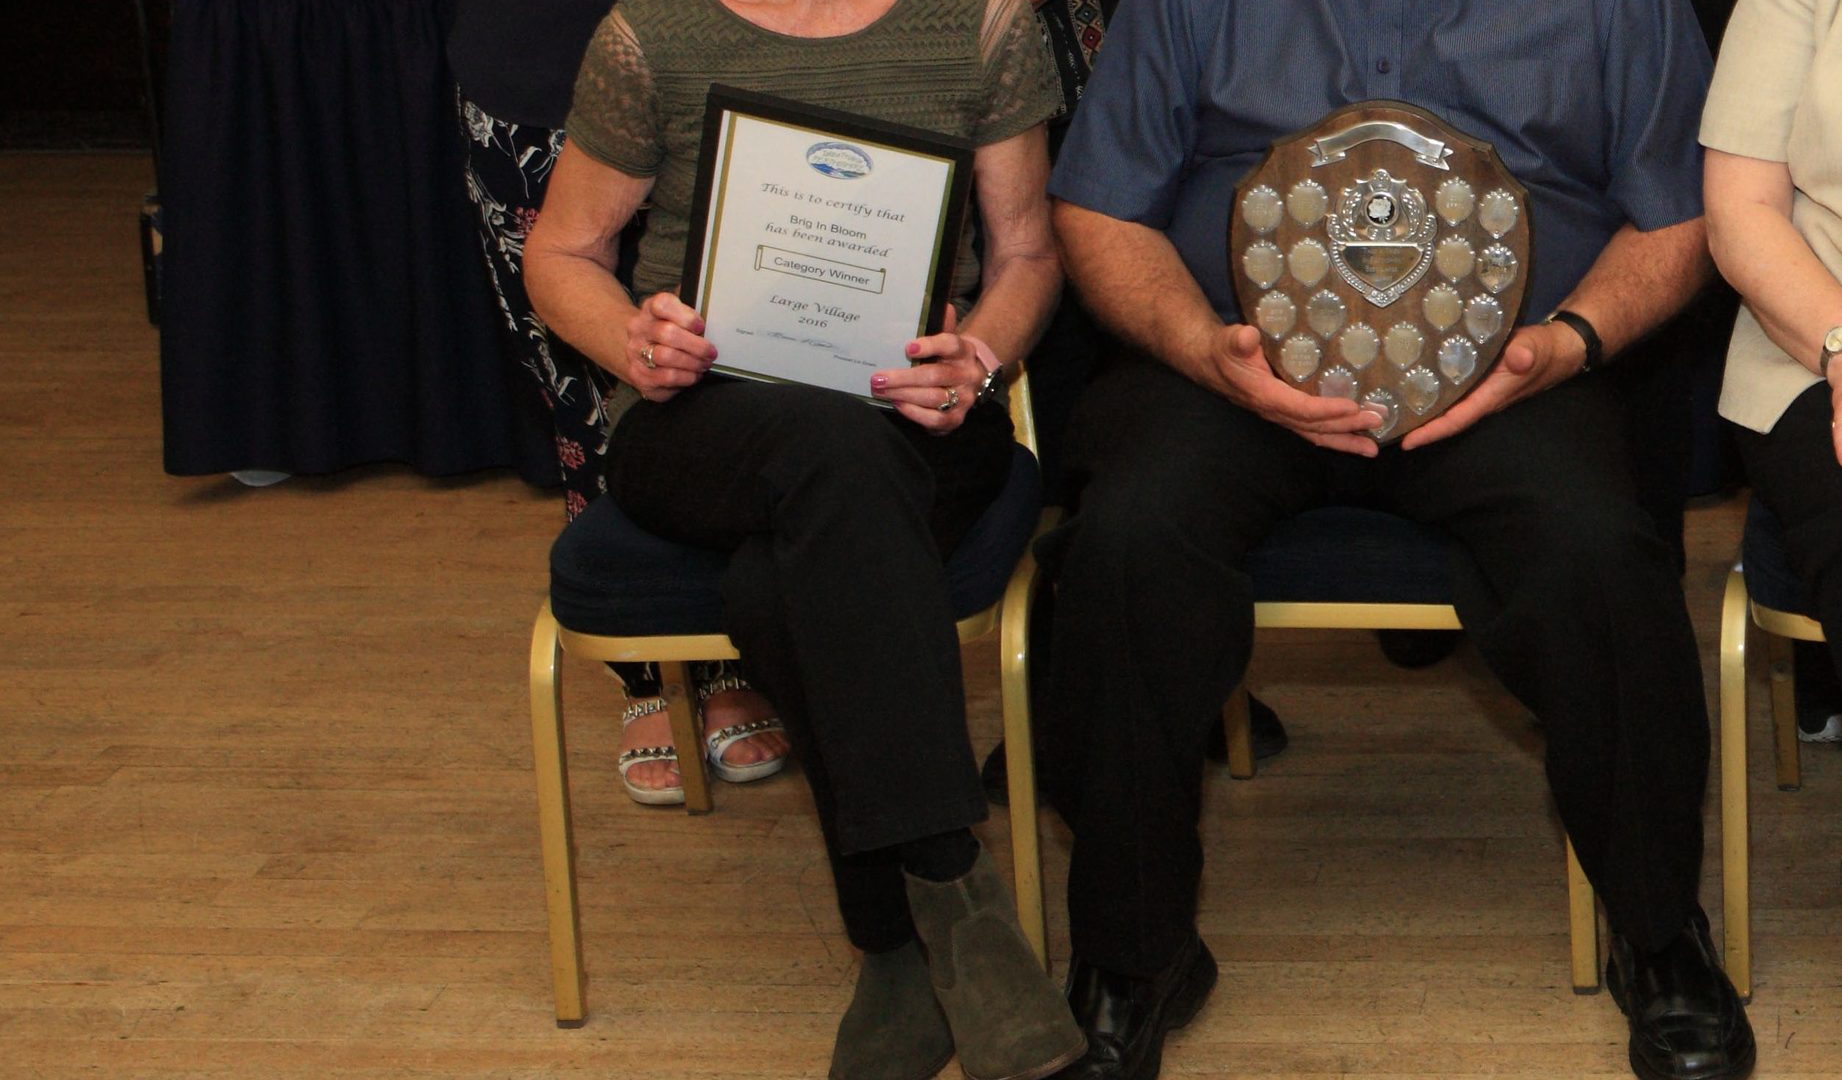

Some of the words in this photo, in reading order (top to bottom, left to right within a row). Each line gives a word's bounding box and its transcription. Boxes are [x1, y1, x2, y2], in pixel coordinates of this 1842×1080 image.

[761, 182, 790, 196] This
[794, 190, 804, 201] is
[808, 192, 823, 205] to
[826, 198, 873, 218] certify
[876, 208, 905, 223] that
[765, 222, 788, 236] has
[792, 226, 823, 244] been
[827, 238, 892, 258] awarded
[790, 214, 813, 229] Brig
[816, 221, 827, 231] In
[830, 224, 867, 239] Bloom
[774, 256, 826, 277] Category
[829, 268, 871, 286] Winner
[769, 294, 809, 311] Large
[813, 302, 861, 322] Village
[797, 315, 829, 328] 2016
